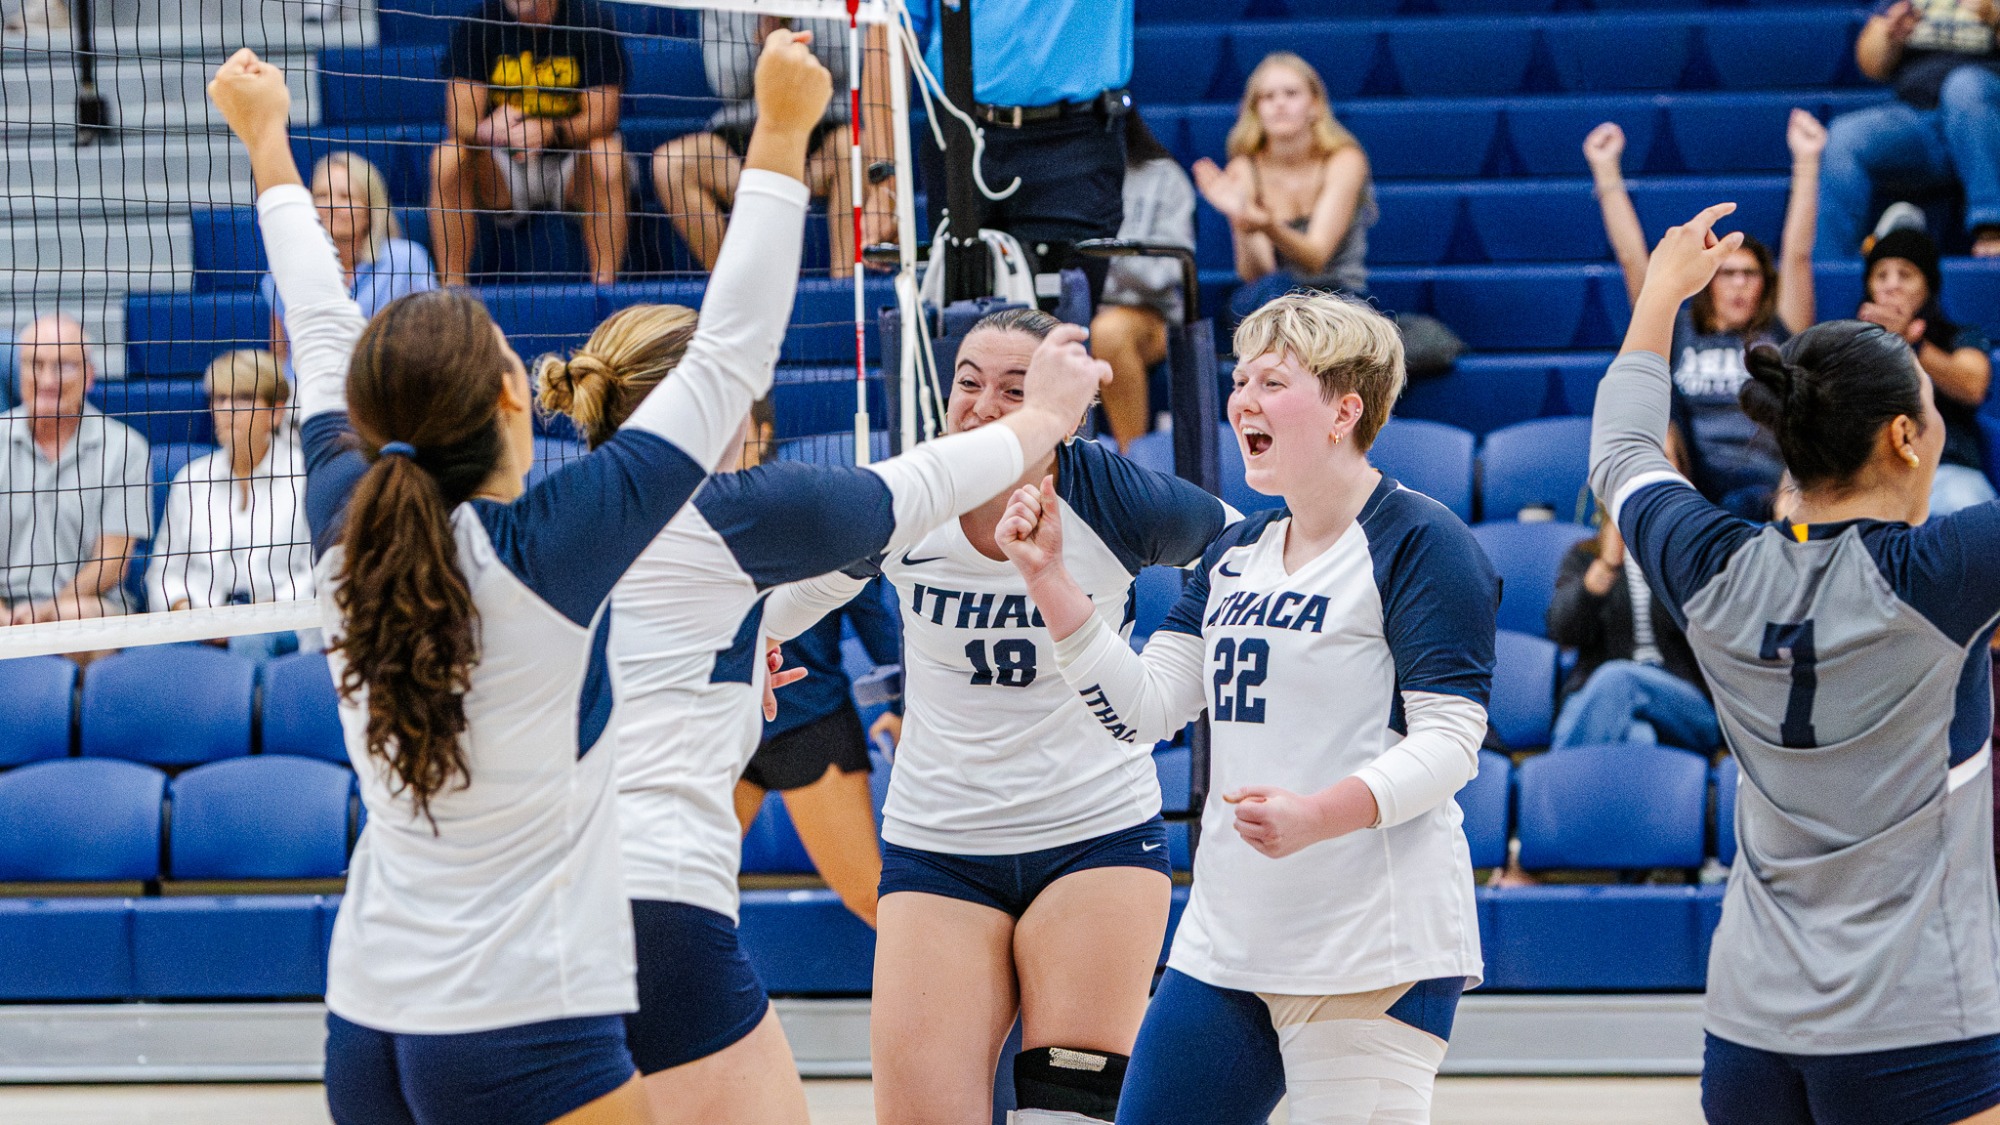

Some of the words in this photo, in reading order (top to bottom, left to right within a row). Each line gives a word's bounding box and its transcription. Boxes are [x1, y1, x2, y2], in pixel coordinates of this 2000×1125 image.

[911, 583, 1093, 629] ITHA
[964, 638, 1037, 688] 18
[1212, 637, 1270, 724] 22
